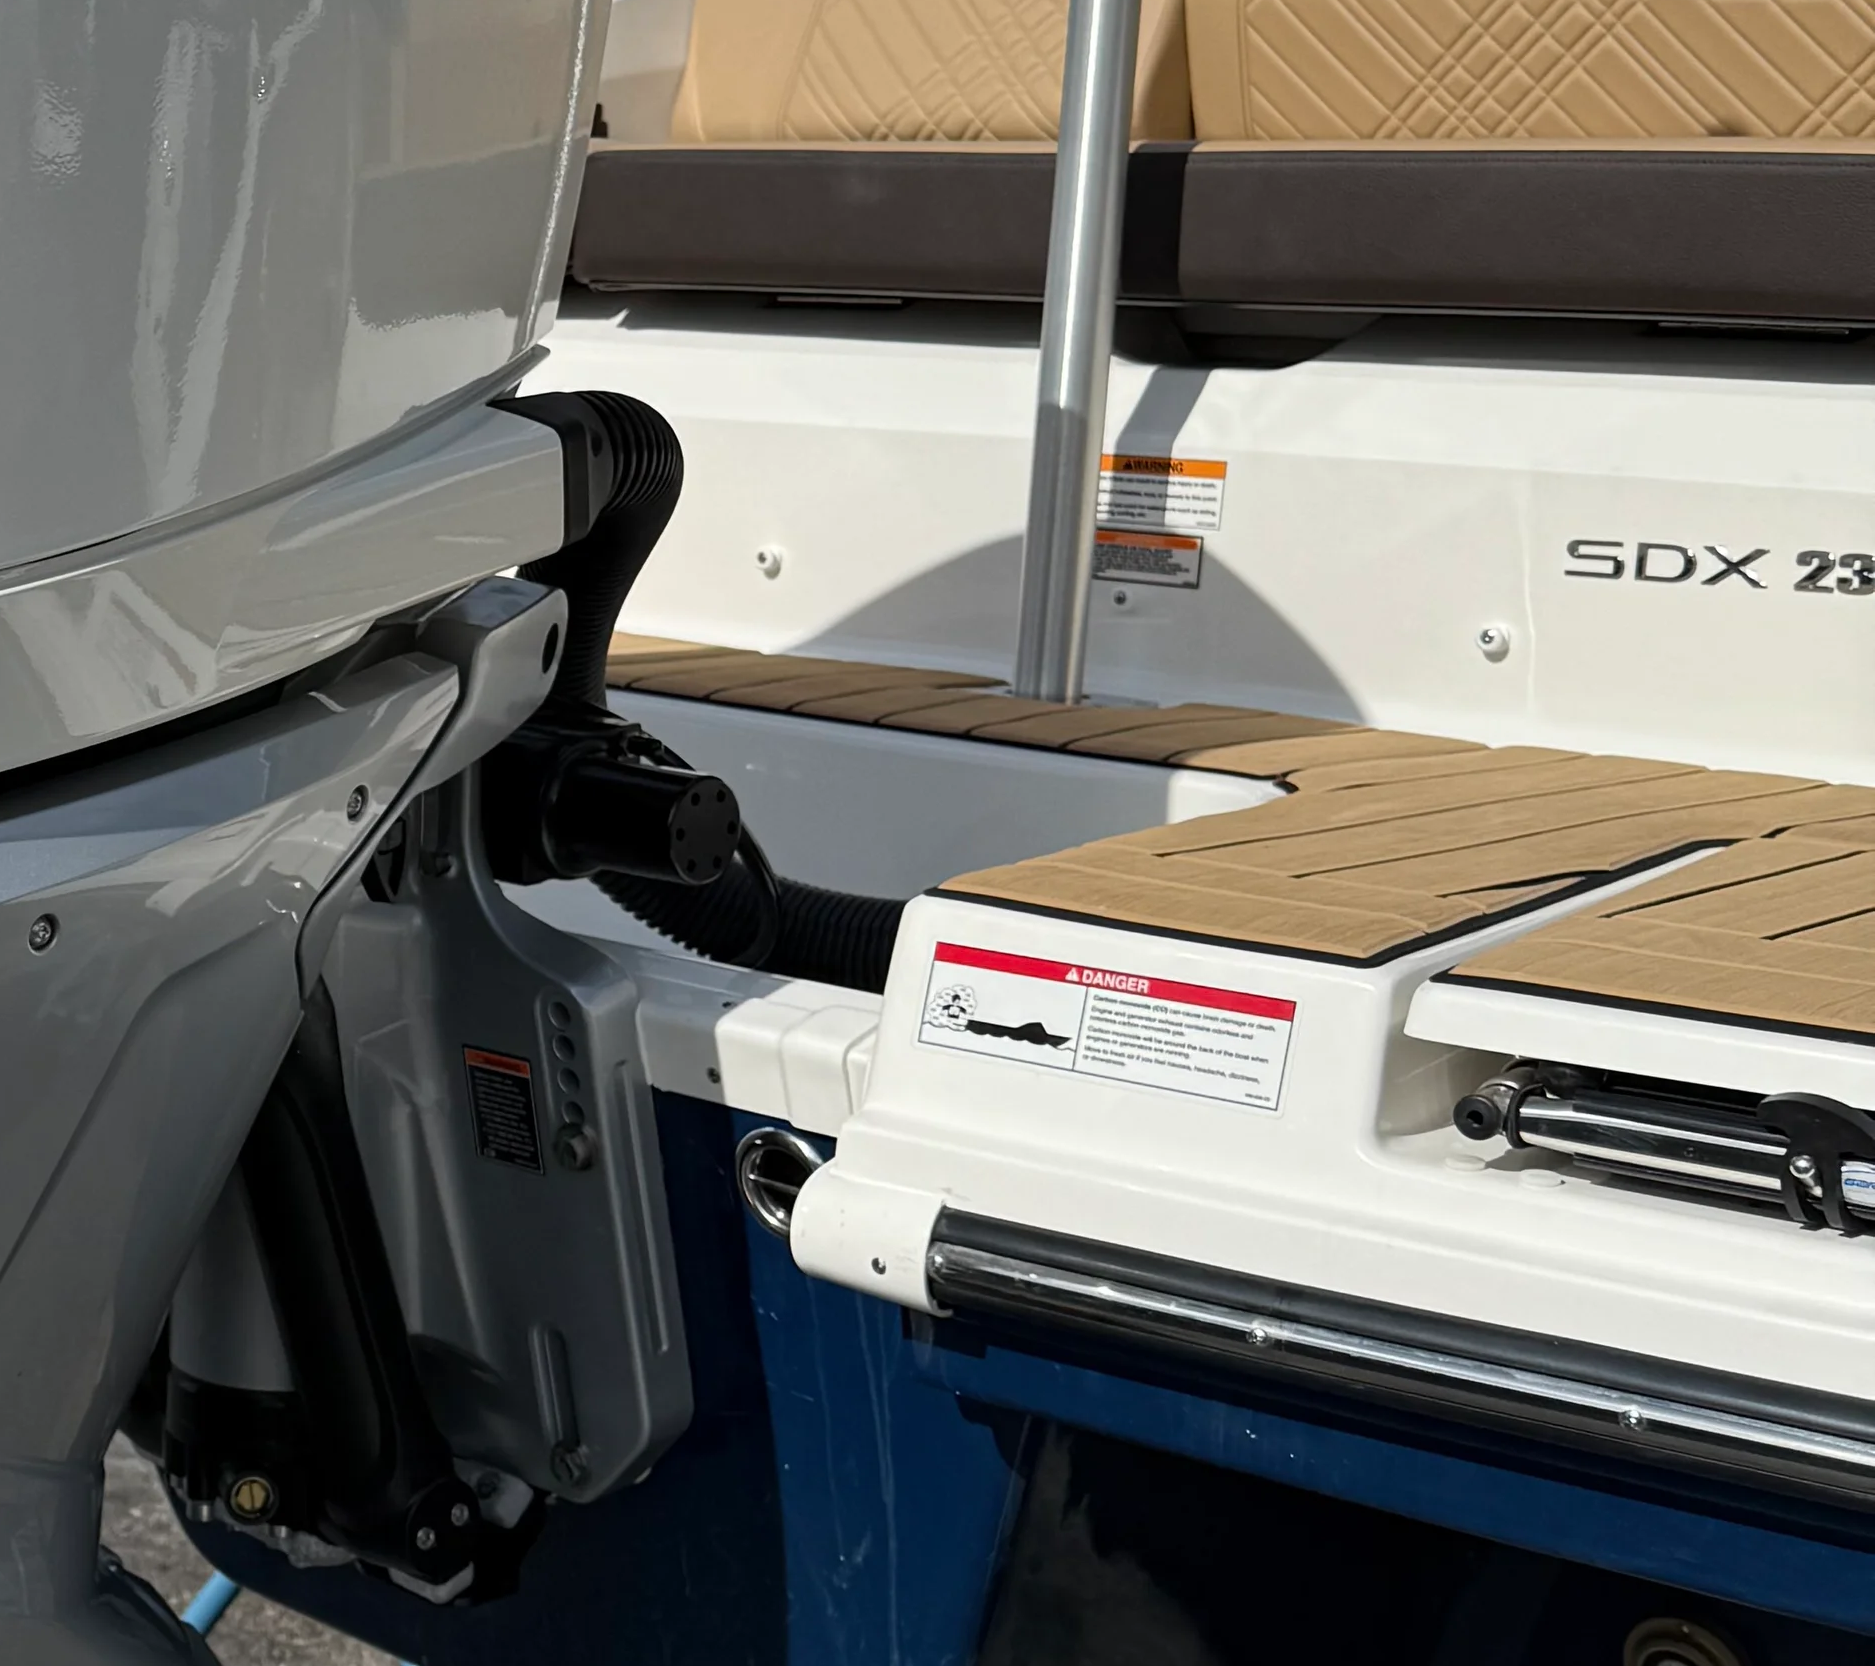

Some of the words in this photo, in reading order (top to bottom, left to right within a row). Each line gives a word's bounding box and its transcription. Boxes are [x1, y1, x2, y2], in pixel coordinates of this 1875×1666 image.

[1132, 460, 1184, 474] WARNING
[1564, 539, 1771, 590] SDX
[1081, 970, 1149, 994] DANGER
